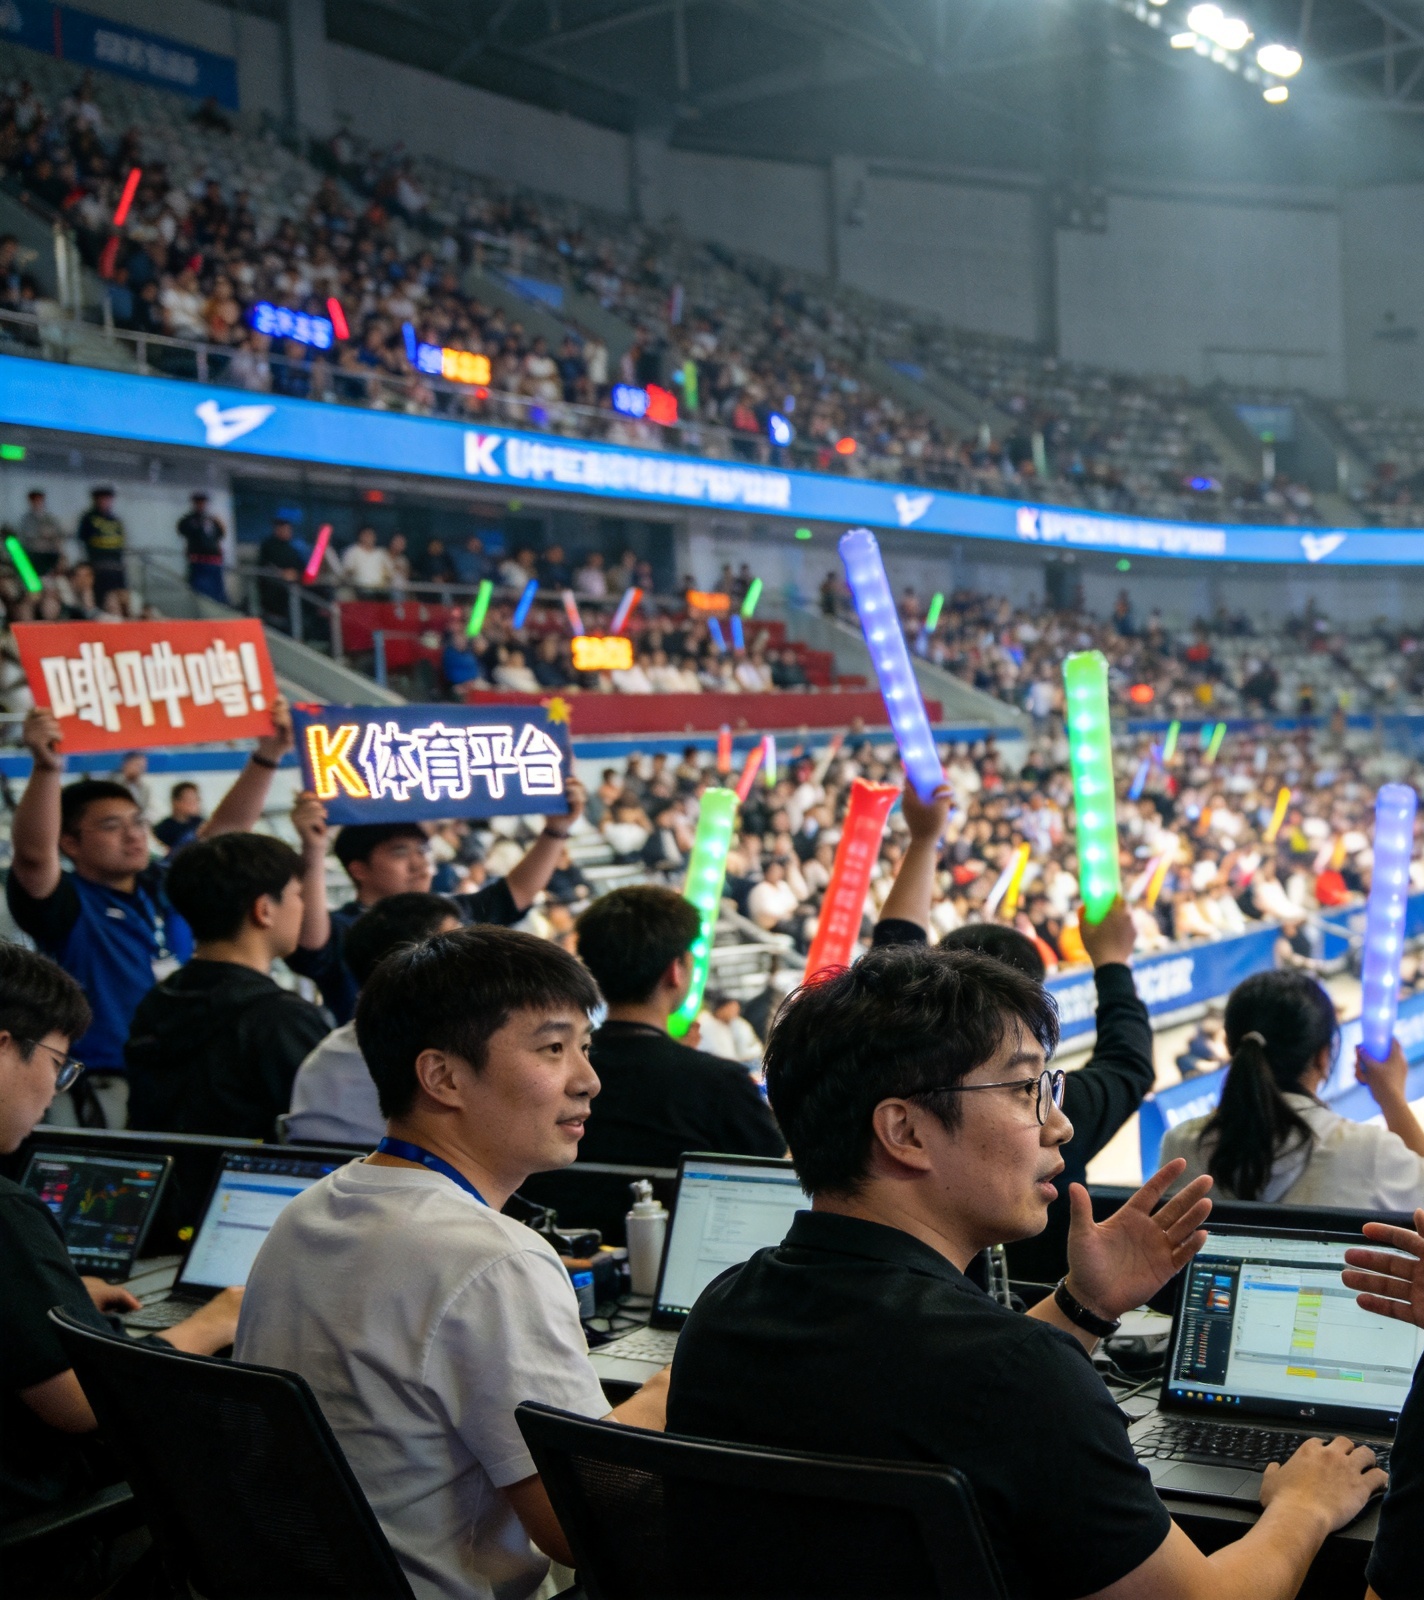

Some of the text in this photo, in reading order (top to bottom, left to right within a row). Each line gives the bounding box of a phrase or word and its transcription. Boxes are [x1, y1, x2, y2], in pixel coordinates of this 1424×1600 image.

[464, 431, 501, 476] K
[305, 722, 563, 801] K体育平台
